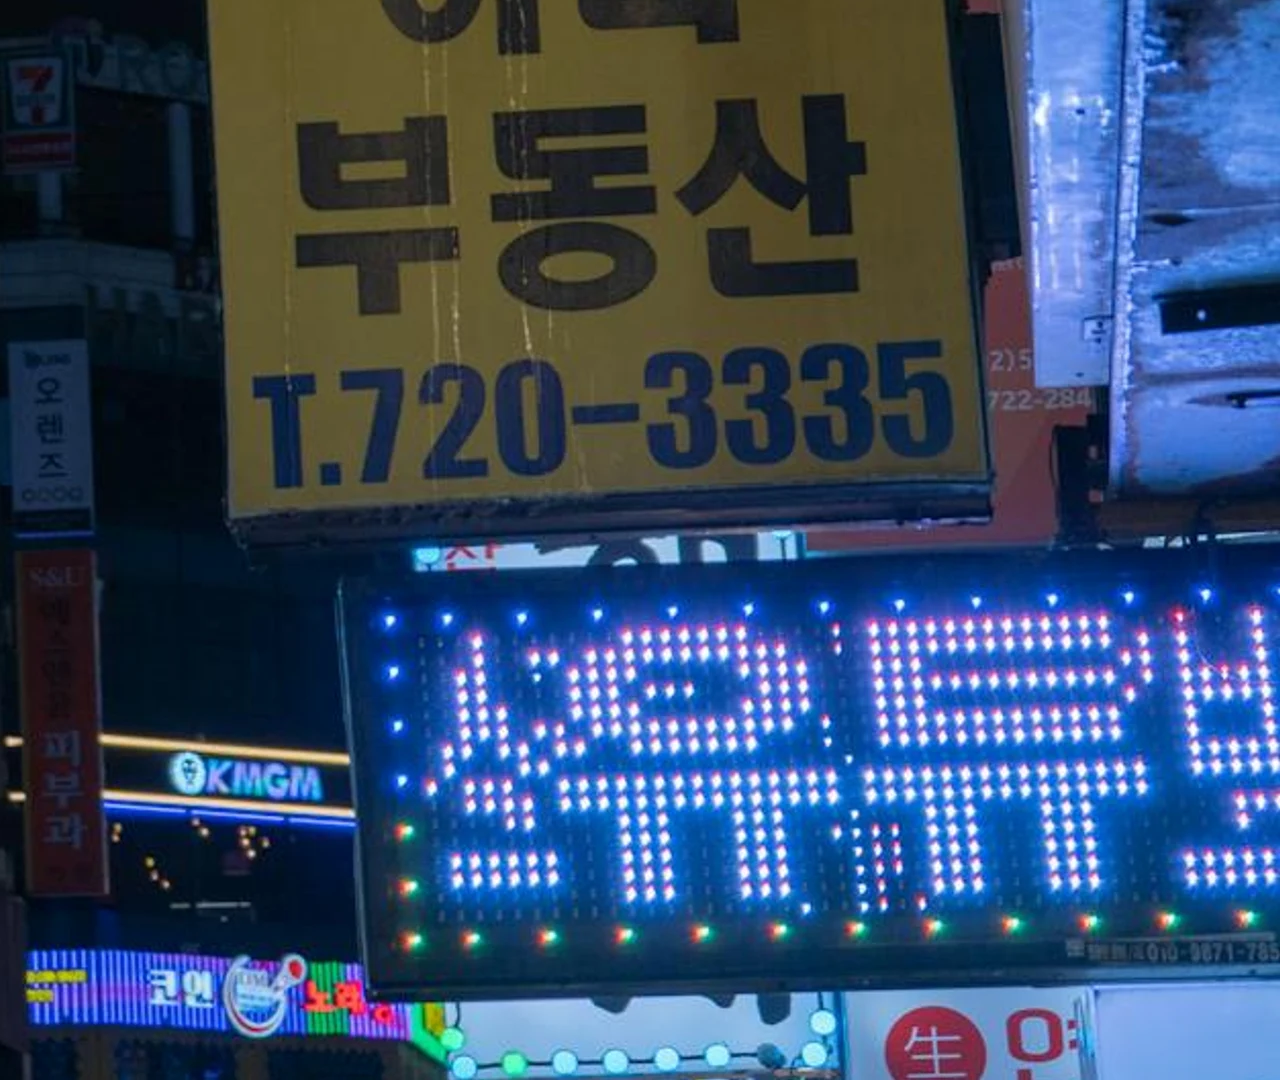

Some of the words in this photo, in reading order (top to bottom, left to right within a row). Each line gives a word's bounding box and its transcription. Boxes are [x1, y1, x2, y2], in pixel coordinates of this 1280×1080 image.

[293, 92, 867, 317] 부동산
[250, 338, 956, 490] T.720-3335
[42, 728, 88, 851] 피부과
[203, 757, 325, 803] KMGM
[149, 968, 215, 1009] 코인
[904, 1024, 968, 1080] 生
